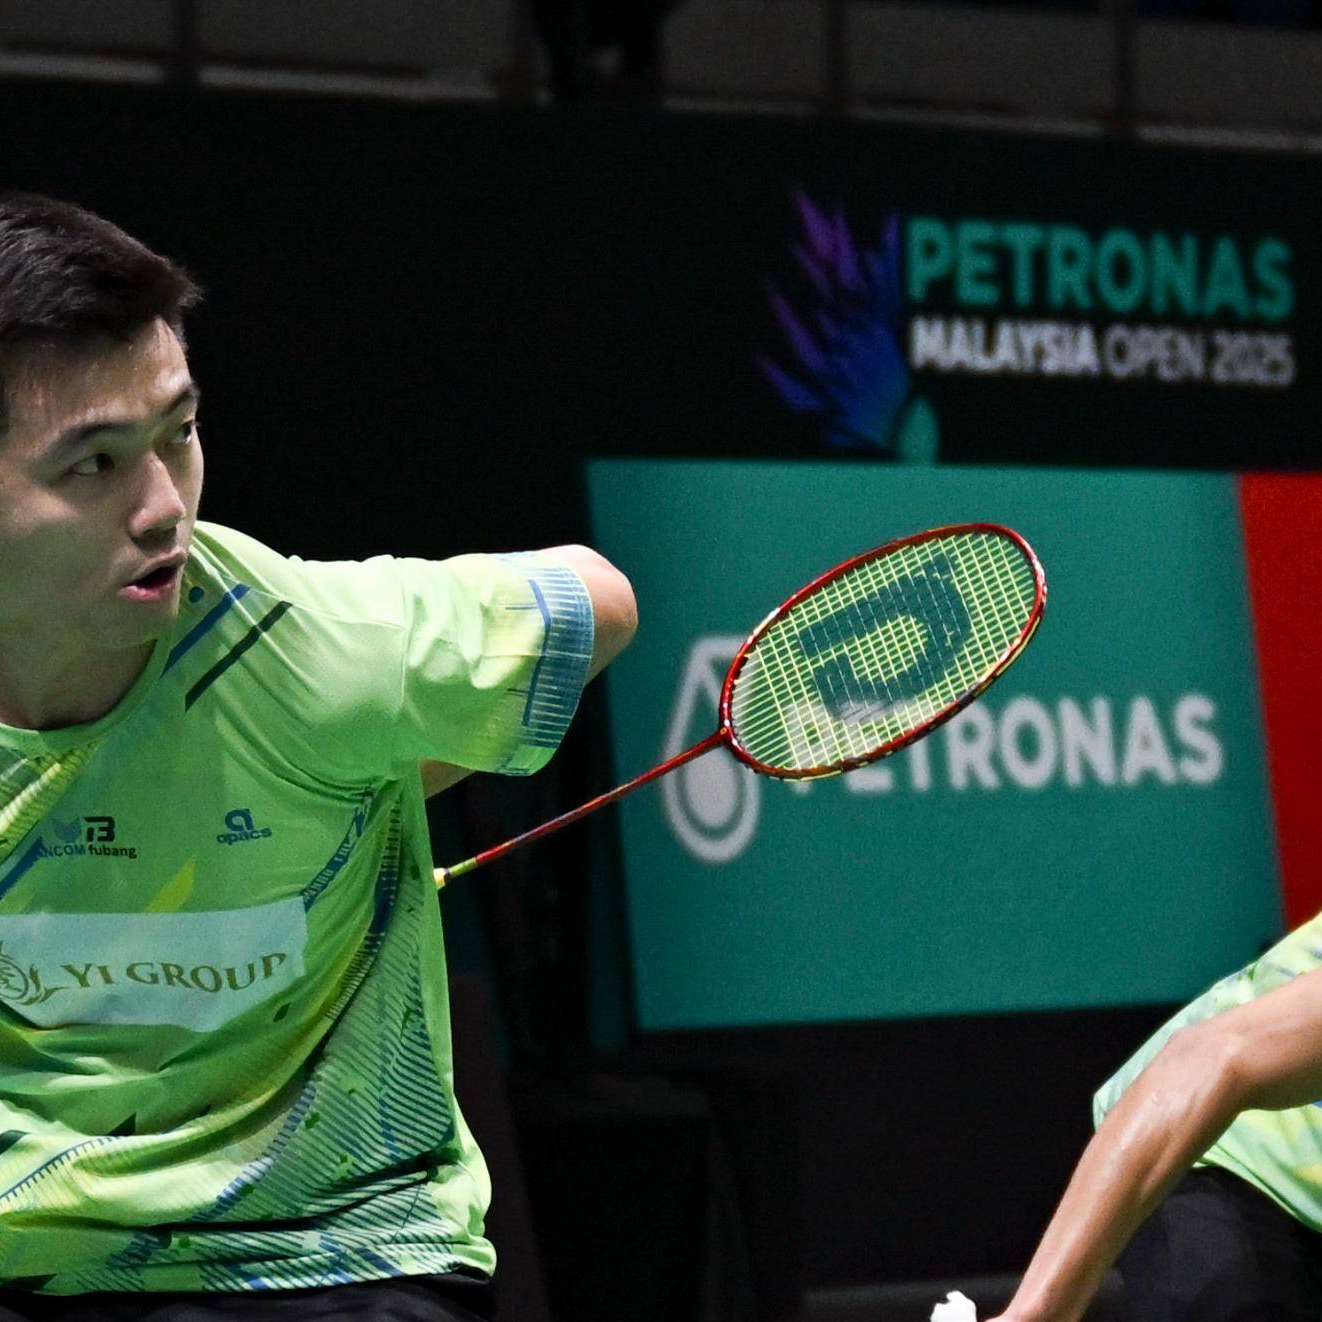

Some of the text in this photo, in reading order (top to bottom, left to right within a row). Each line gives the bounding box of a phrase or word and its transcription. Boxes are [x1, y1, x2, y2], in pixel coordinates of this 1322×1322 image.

[906, 216, 1296, 318] PETRONAS
[910, 315, 1101, 376] MALAYSIA
[1103, 324, 1207, 382] OPEN
[60, 952, 287, 993] YI GROUP
